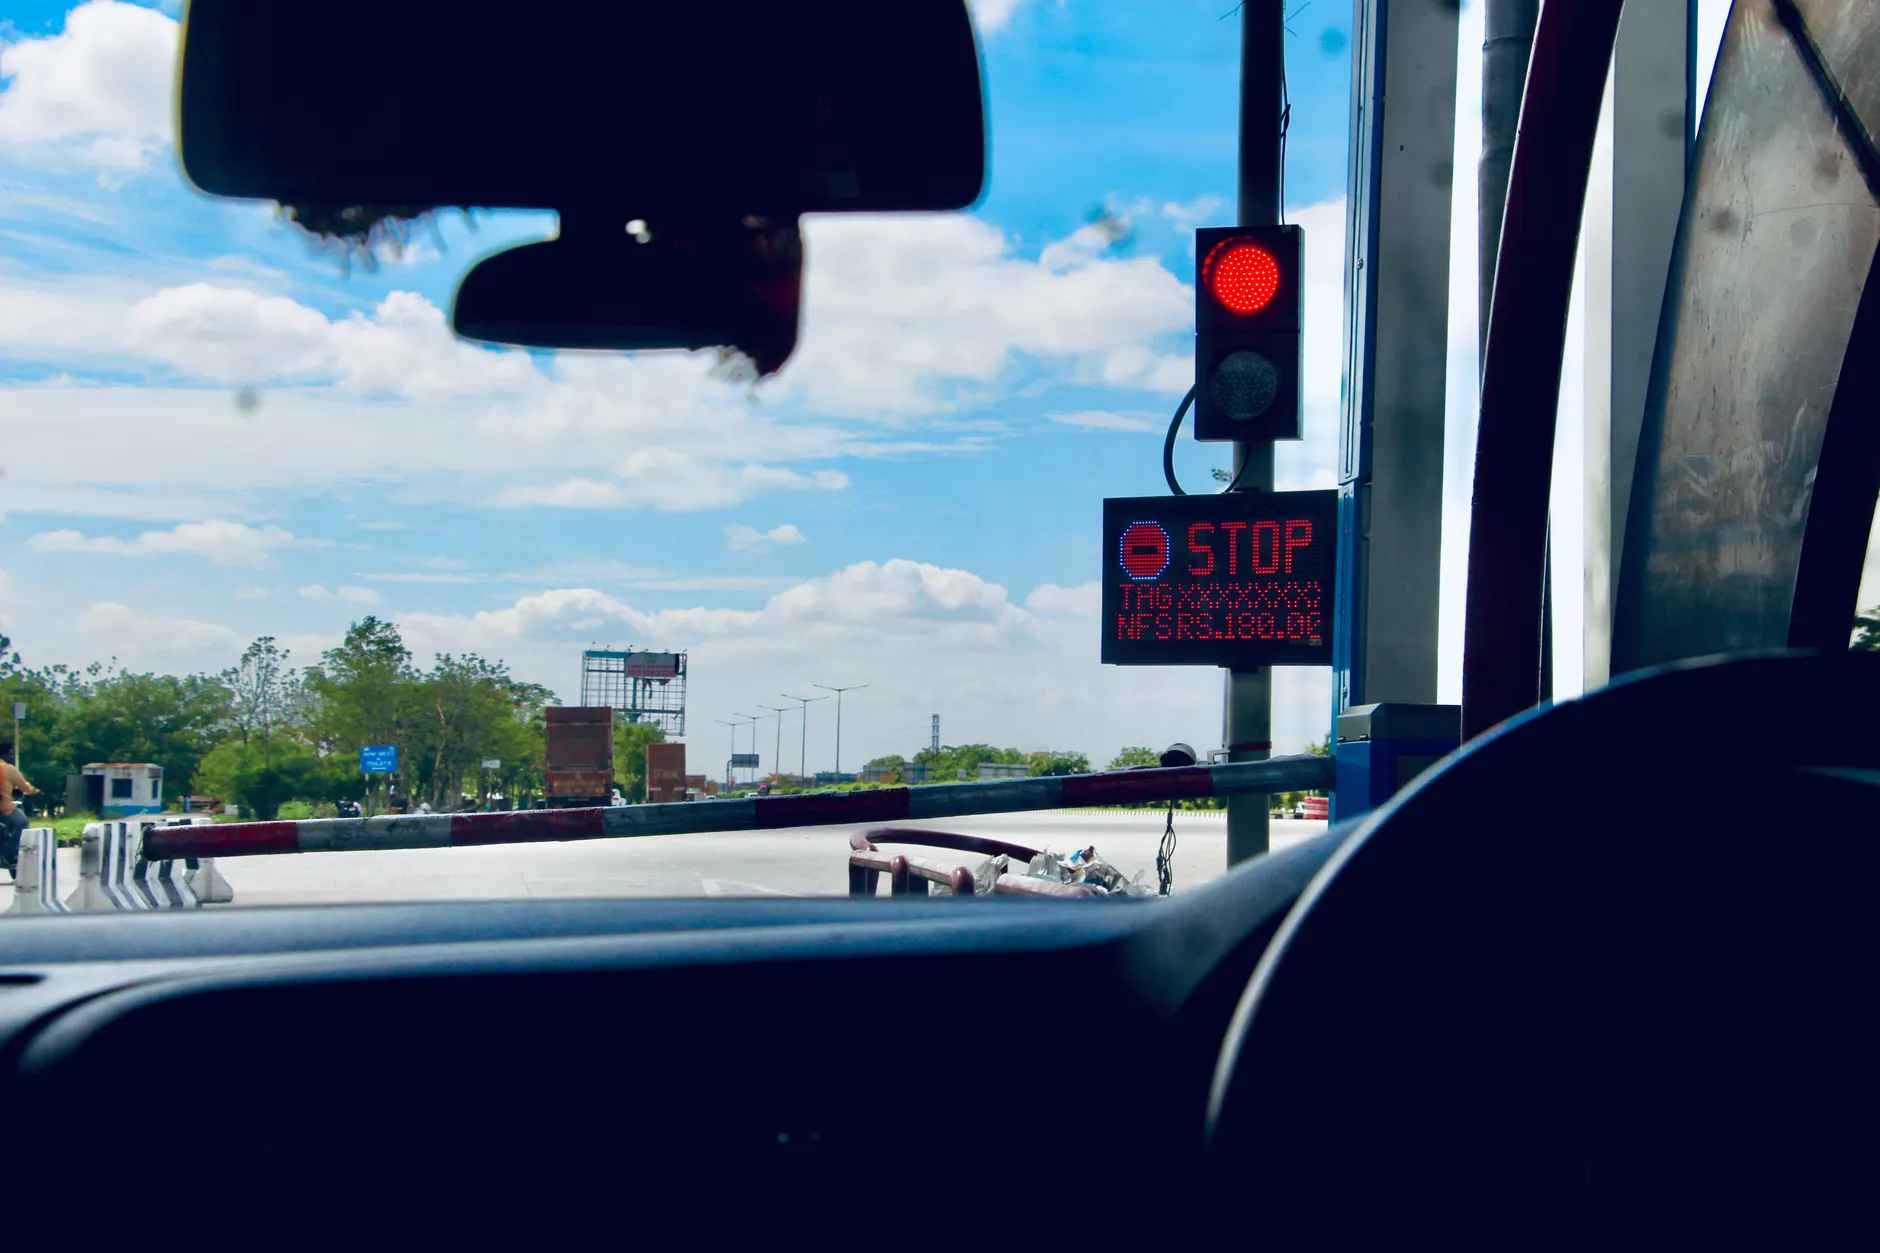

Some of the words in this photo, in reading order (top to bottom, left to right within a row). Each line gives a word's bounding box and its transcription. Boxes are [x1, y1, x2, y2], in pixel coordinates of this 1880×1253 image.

[1187, 519, 1313, 575] STOP
[1119, 583, 1173, 610] TAG
[1117, 613, 1172, 639] NFS
